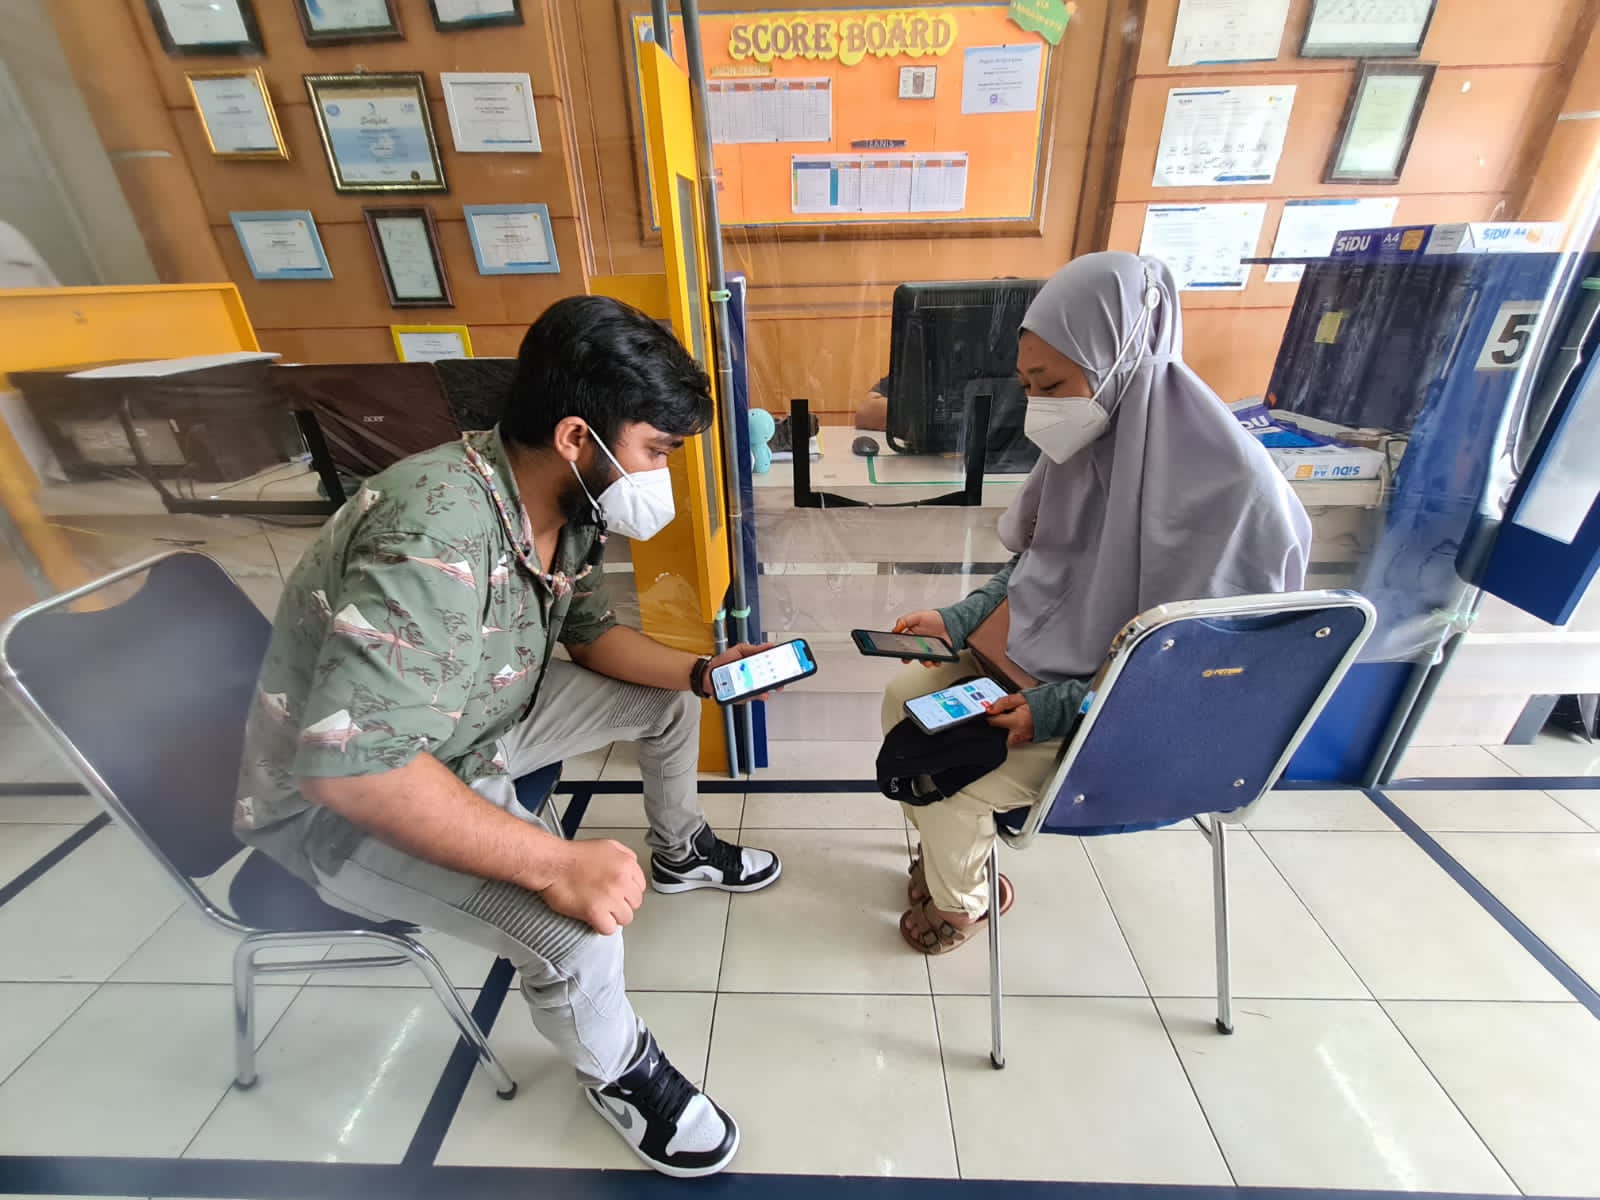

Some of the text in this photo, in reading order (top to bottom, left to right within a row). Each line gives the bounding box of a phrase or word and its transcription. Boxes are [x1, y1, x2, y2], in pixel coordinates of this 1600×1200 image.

[731, 18, 951, 54] SCORE BOARD
[1483, 227, 1511, 240] SiDU
[1336, 232, 1400, 252] SiDU A4
[1491, 313, 1539, 364] 5
[363, 415, 385, 423] acer
[1241, 415, 1270, 430] DU
[1331, 465, 1360, 477] SiDU
